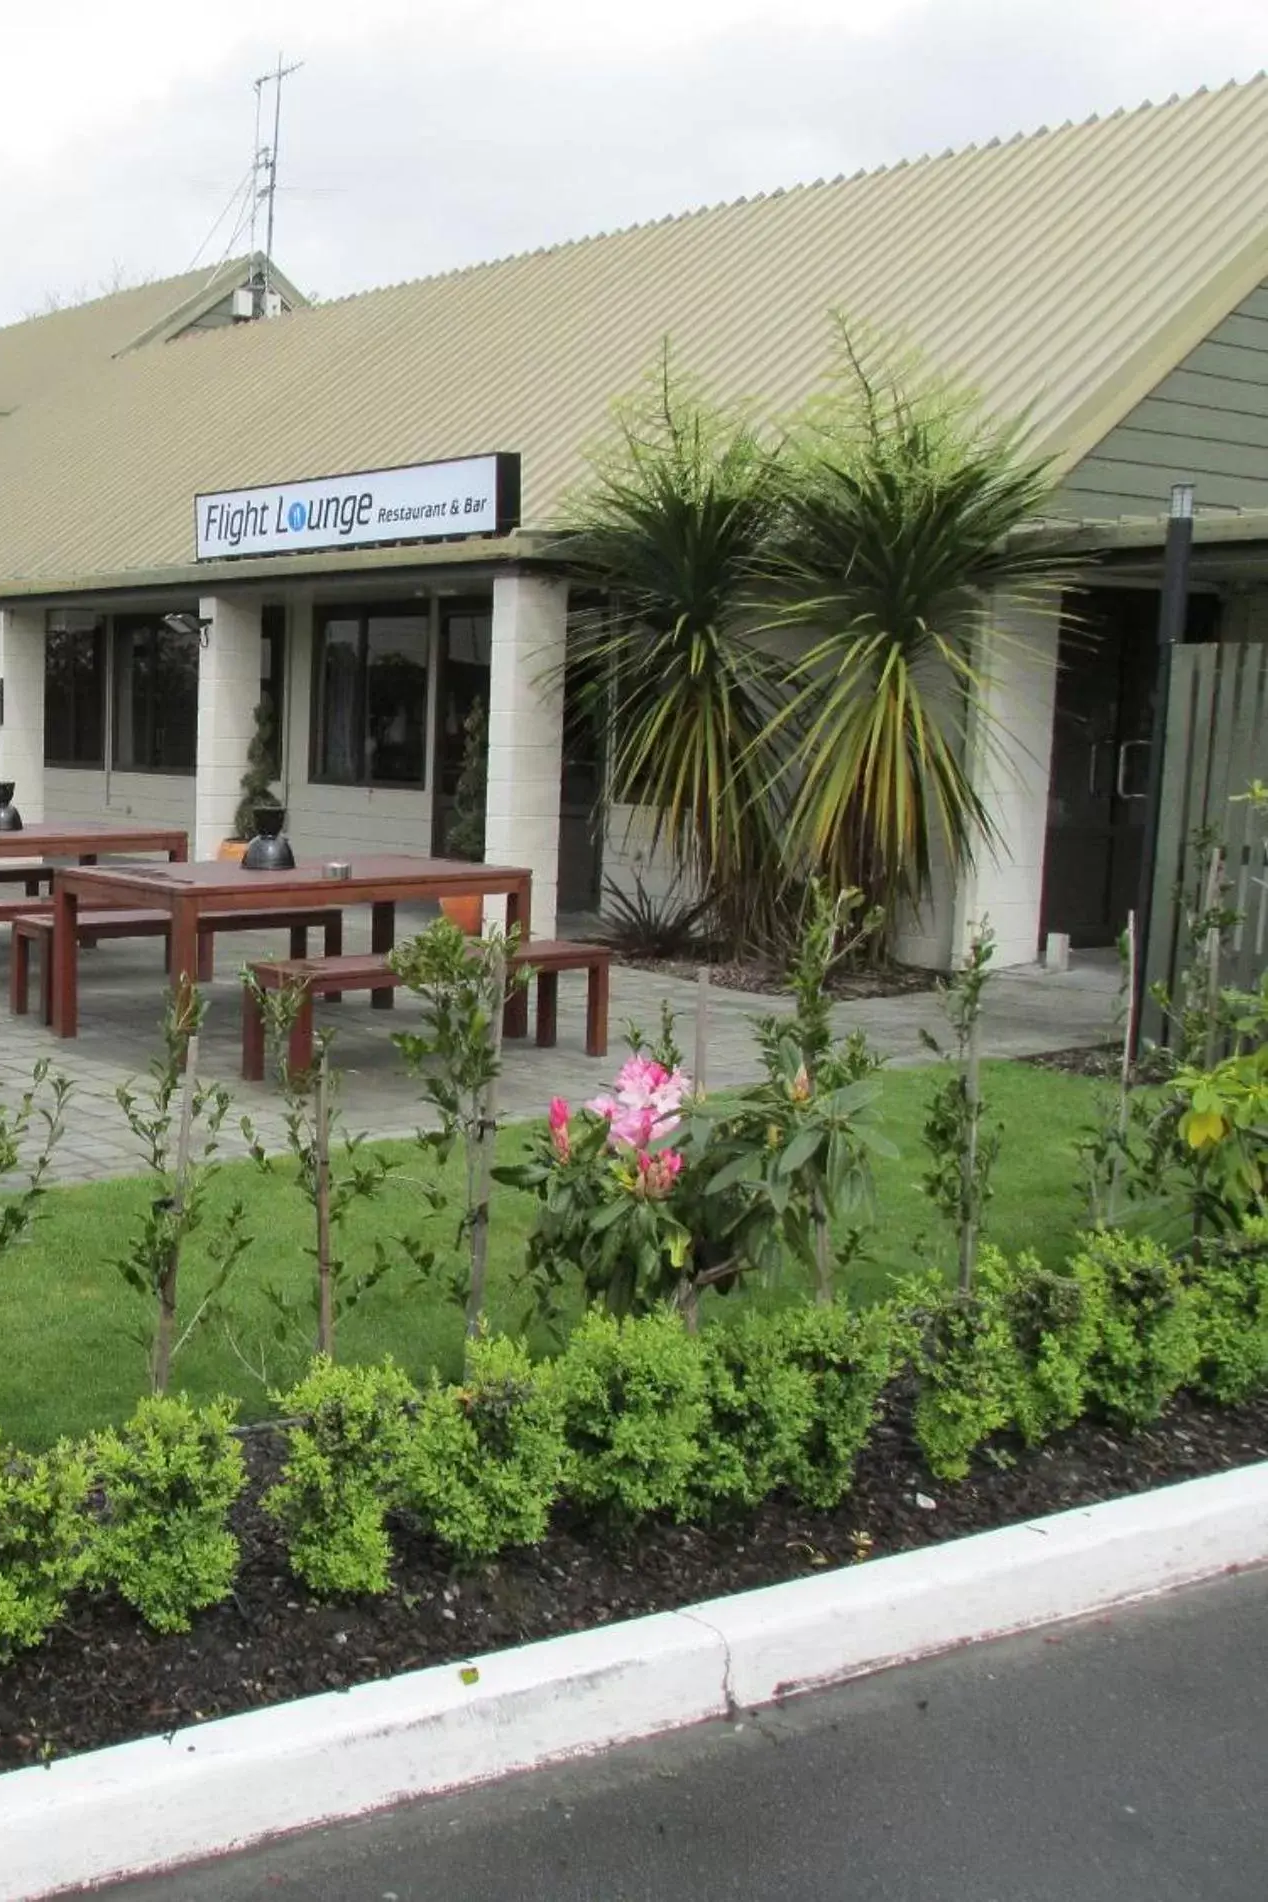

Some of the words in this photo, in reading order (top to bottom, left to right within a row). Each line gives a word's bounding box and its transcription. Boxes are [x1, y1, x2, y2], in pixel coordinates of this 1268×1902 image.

[204, 499, 270, 546] Flight
[274, 492, 373, 535] Lounge
[378, 502, 446, 523] Restaurant
[449, 498, 460, 515] &
[464, 496, 487, 514] Bar
